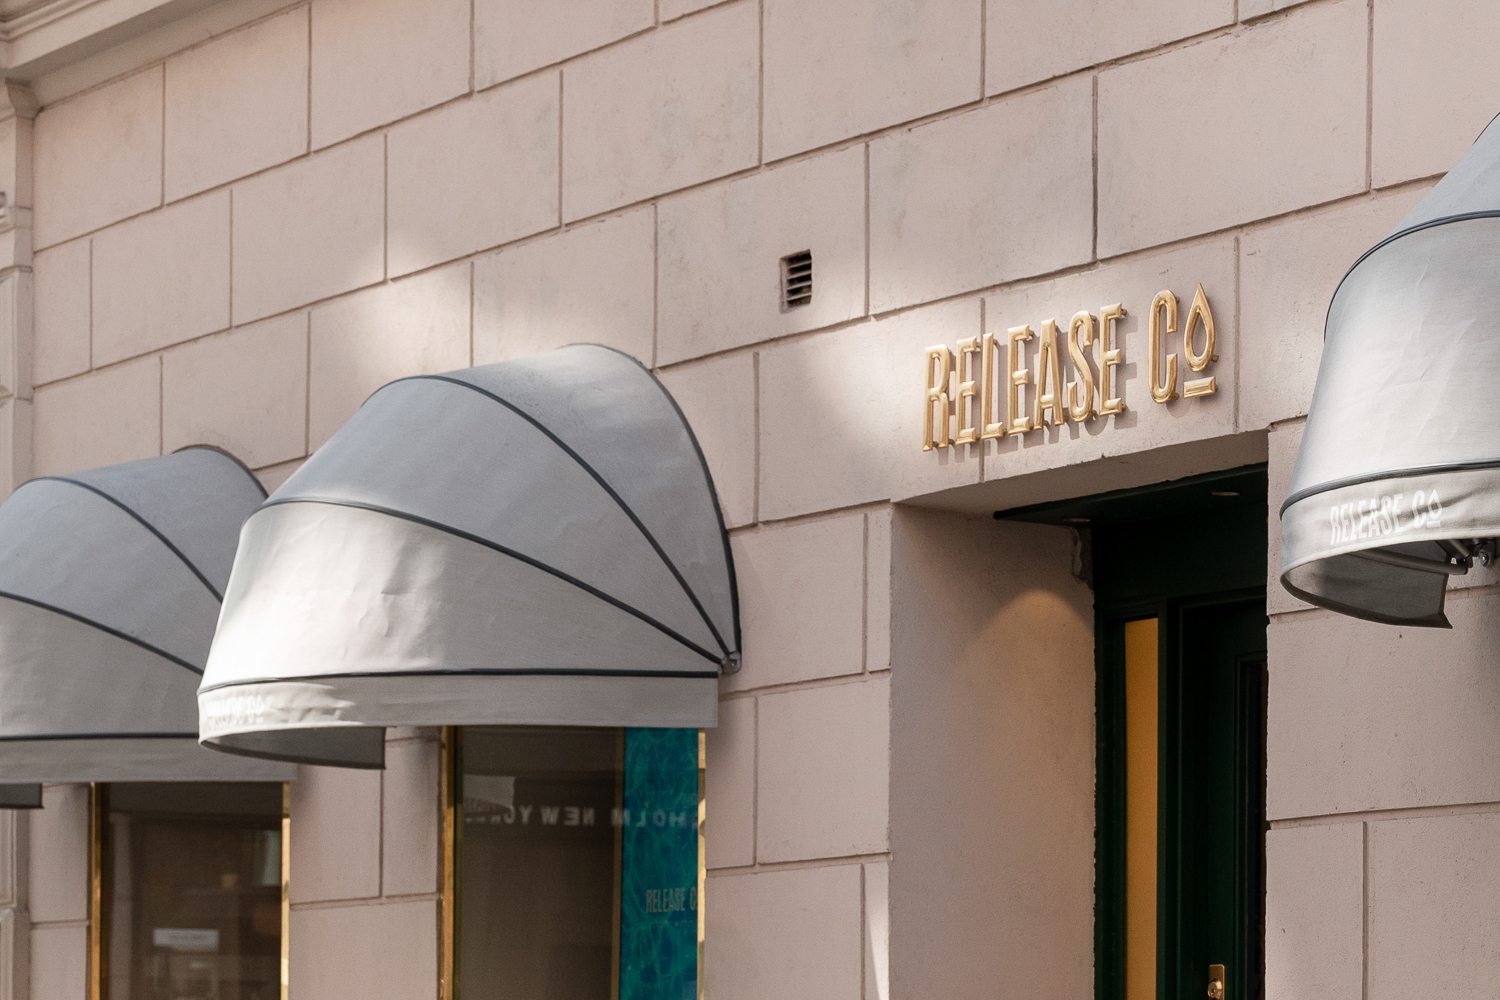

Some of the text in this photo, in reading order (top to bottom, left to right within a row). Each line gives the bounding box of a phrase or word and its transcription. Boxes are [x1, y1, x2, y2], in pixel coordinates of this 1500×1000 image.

[922, 302, 1122, 452] RELEASE
[1330, 493, 1404, 546] RELEASE
[646, 887, 686, 913] RELEASE
